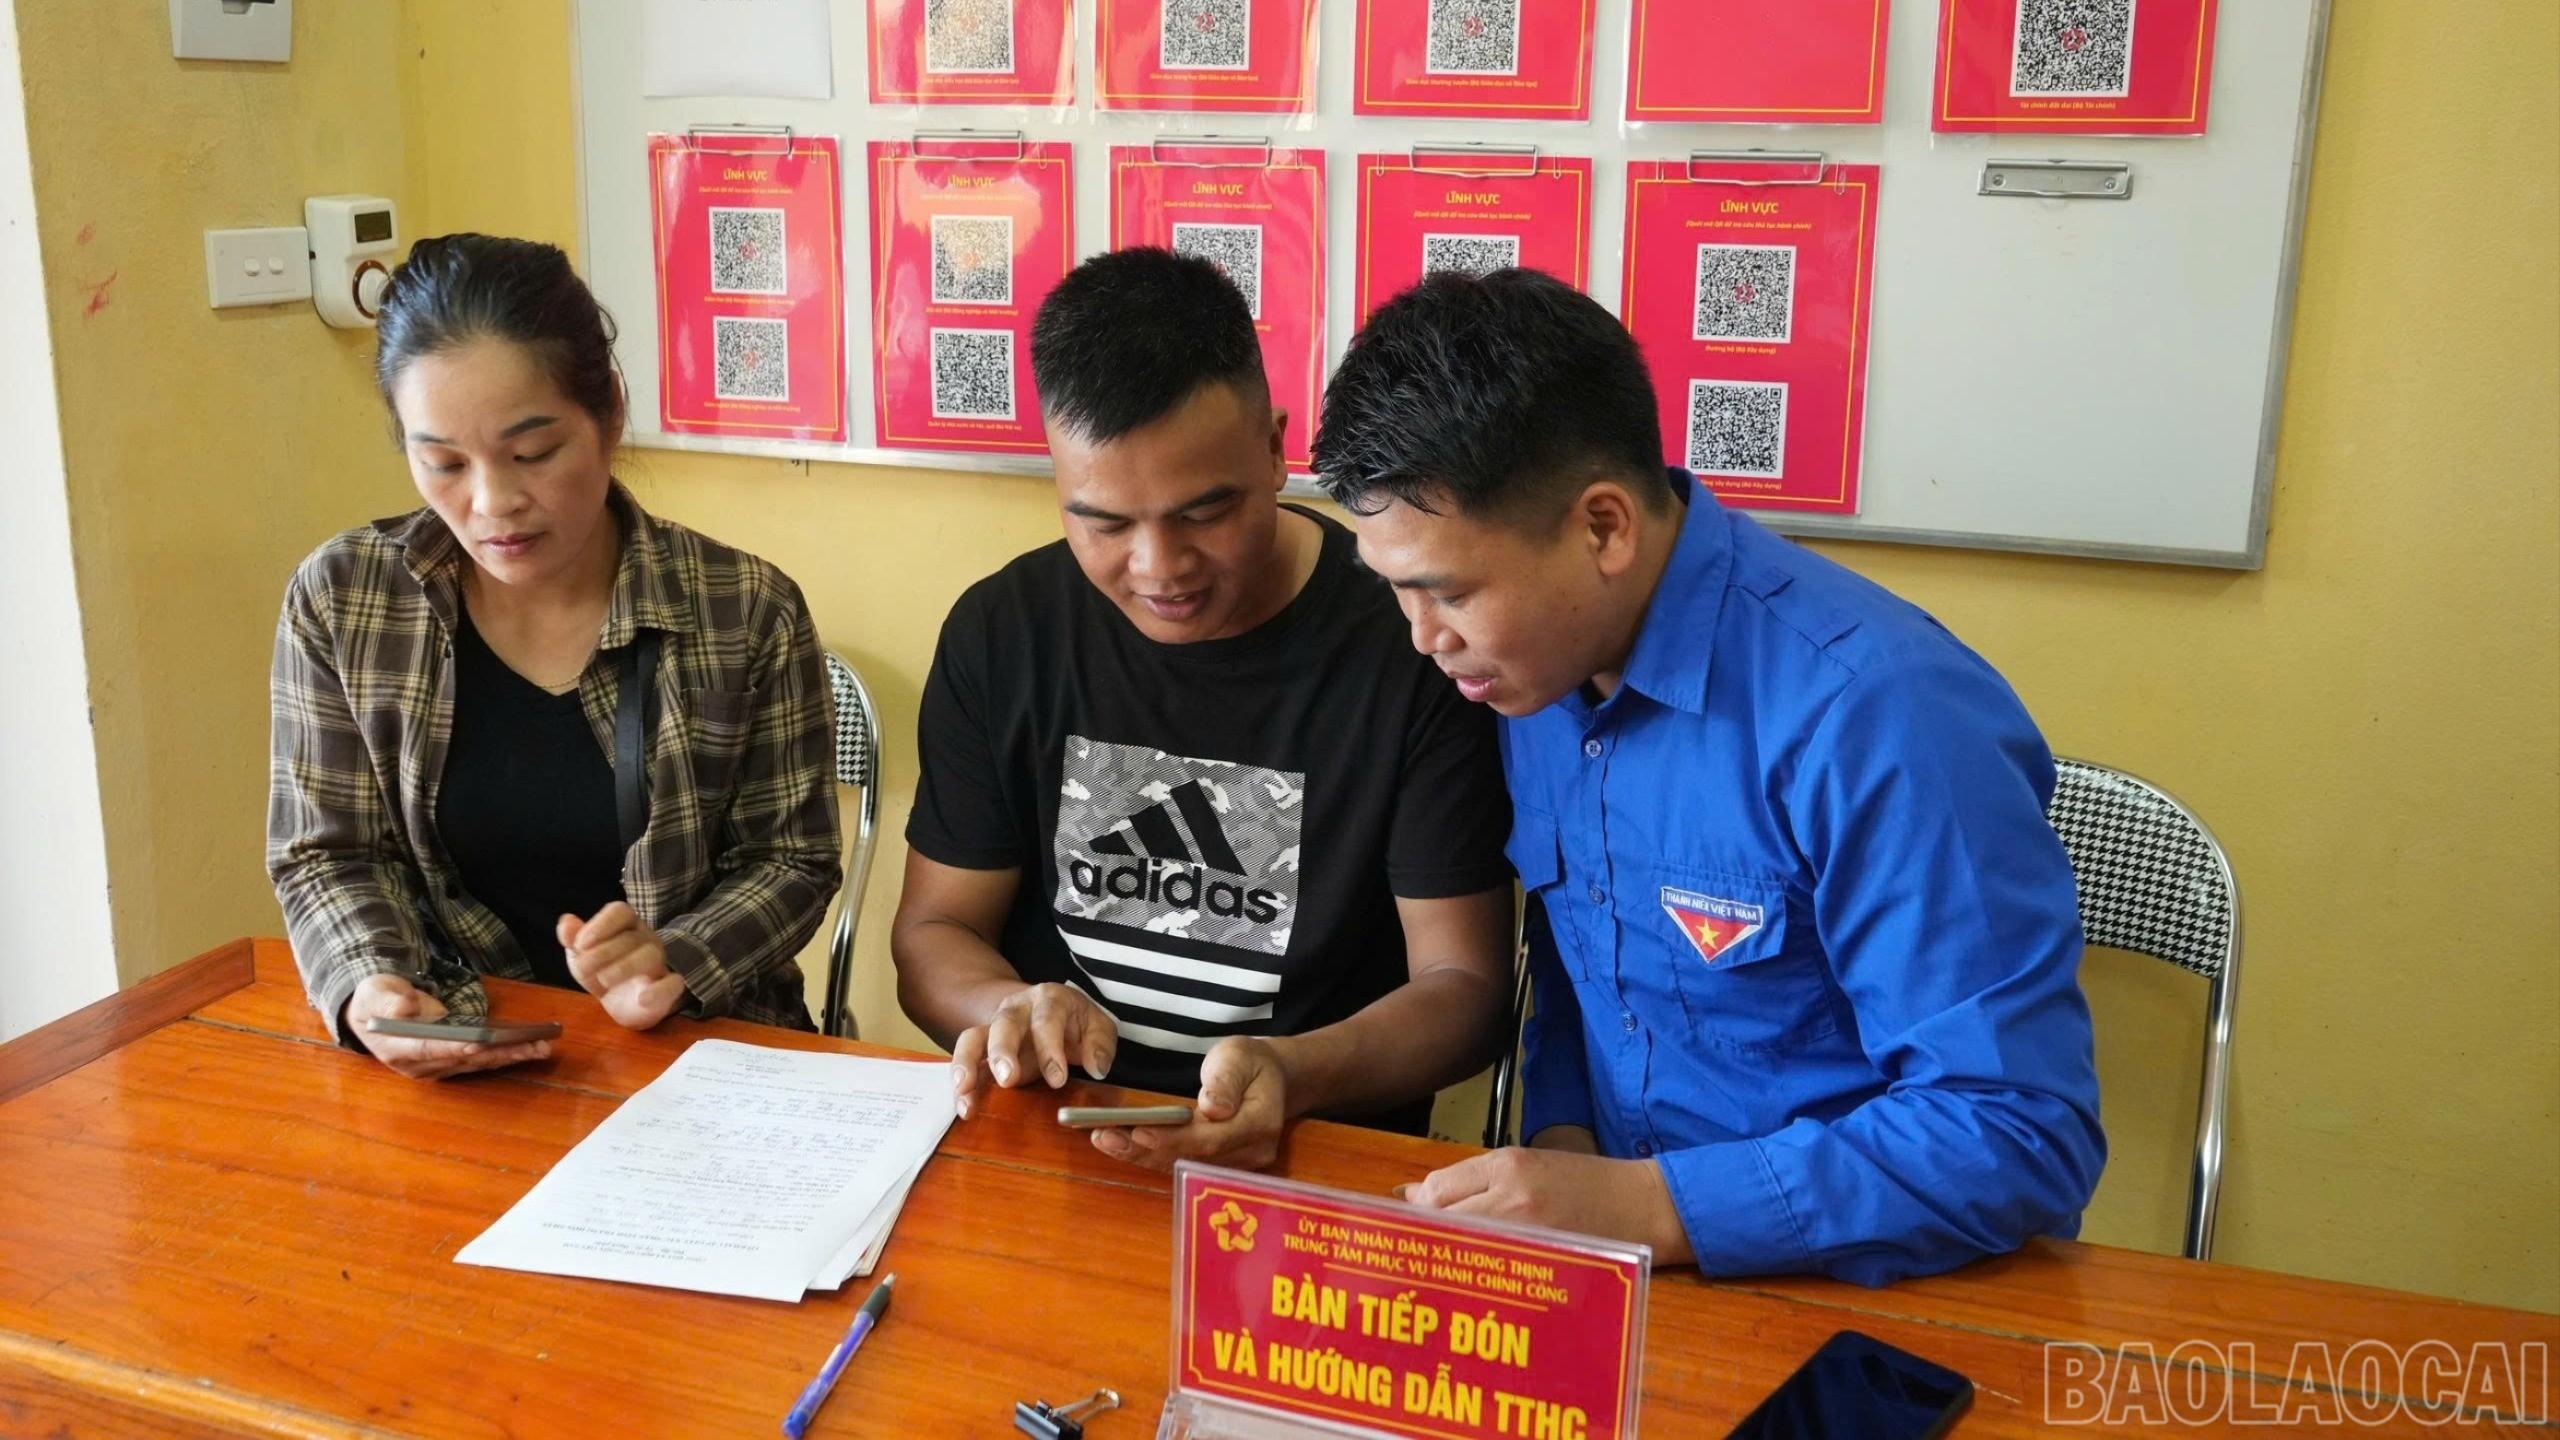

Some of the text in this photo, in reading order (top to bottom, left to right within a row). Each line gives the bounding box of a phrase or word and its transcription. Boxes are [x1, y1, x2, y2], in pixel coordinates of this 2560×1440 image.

[1193, 181, 1243, 197] LĨNH VỰC
[1446, 191, 1500, 206] LĨNH VỰC
[1720, 200, 1779, 215] LĨNH VỰC
[1068, 857, 1279, 925] adidas
[1666, 892, 1691, 907] THANH
[1734, 908, 1757, 921] NAM
[1283, 1233, 1569, 1304] TRUNG TÂM PHỤC VỤ HÀNH CHÍNH CÔNG
[1321, 1223, 1350, 1241] BAN
[1353, 1230, 1394, 1251] NHÂN
[1398, 1237, 1428, 1257] DÂN
[1432, 1244, 1452, 1261] XÃ
[1510, 1260, 1554, 1282] THỊNH
[1271, 1273, 1530, 1368] BÀN TIẾP ĐÓN
[1213, 1326, 1587, 1440] VÀ HƯỚNG DẪN TTHC
